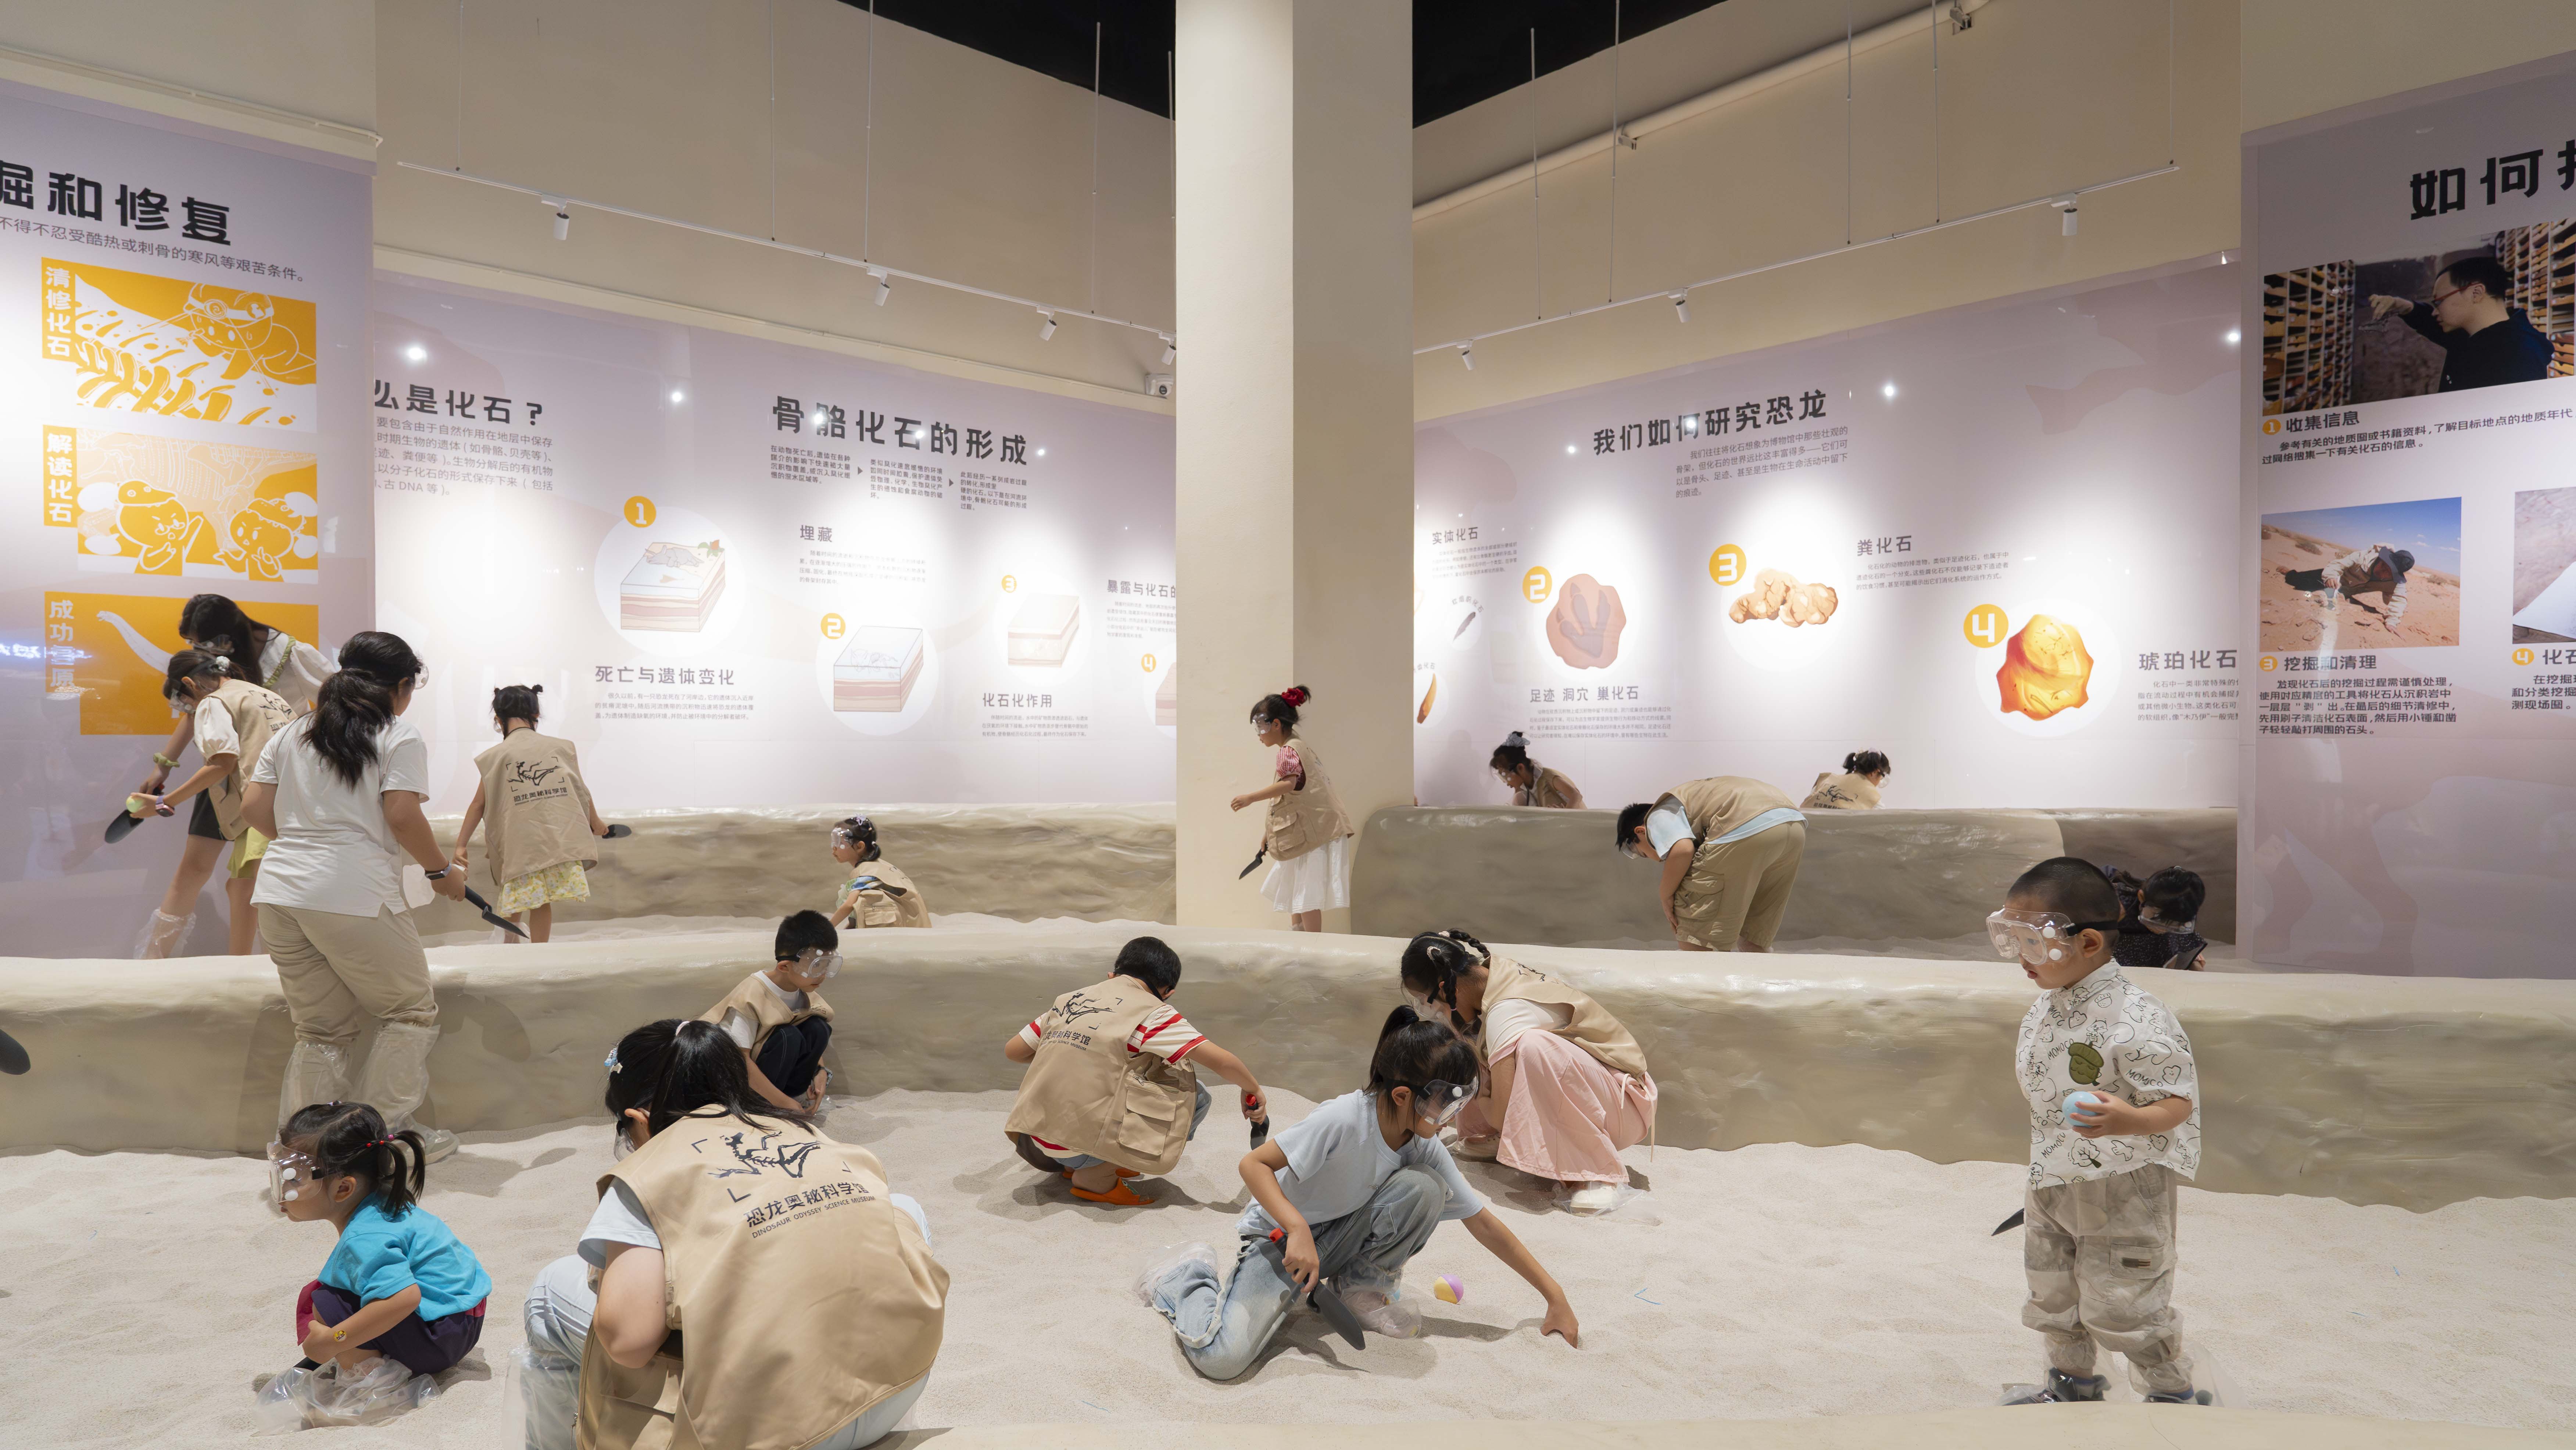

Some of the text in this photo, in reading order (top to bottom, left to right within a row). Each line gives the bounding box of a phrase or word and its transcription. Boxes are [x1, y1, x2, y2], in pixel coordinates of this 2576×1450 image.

[0, 216, 303, 282] 不得不忍受酷热或刺骨的寒风等艰苦条件。
[46, 267, 71, 357] 清修化石
[773, 396, 1027, 466] 骨骼化石的形成
[1593, 388, 1827, 456] 我们如何研究恐龙
[2286, 411, 2360, 433] 收集信息
[374, 432, 552, 462] 时期生物的遗体（如骨骼、贝壳等）、
[1690, 426, 1848, 460] 我们往往将化石想象为博物馆中那些壮观的
[47, 433, 73, 524] 解读化石
[374, 464, 553, 491] 以分子化石的形式保存下来（包括
[374, 479, 395, 490] 、古
[399, 481, 423, 492] DNA
[635, 503, 647, 525] 1
[800, 525, 833, 542] 埋藏
[1432, 526, 1479, 545] 实体化石
[1857, 535, 1912, 556] 粪化石
[1718, 553, 1737, 582] 3
[1005, 578, 1015, 590] 3
[1530, 574, 1546, 600] 2
[828, 618, 841, 637] 2
[1972, 613, 1995, 643] 4
[1144, 657, 1153, 670] 4
[2139, 650, 2237, 671] 琥珀化石
[2284, 655, 2377, 671] 挖掘和清理
[2517, 651, 2529, 663] 4
[595, 665, 735, 685] 死亡与遗体变化
[2533, 674, 2576, 684] 在挖掘
[983, 693, 1052, 708] 化石化作用
[1530, 686, 1638, 703] 足迹 洞穴 巢化石
[2512, 700, 2571, 710] 测现场图。
[2138, 701, 2239, 710] 或其他微小生物。这类化石可
[1070, 1043, 1087, 1051] MUSEUM
[743, 1181, 870, 1228] 恐龙奥秘科学馆
[752, 1217, 791, 1238] DINOSAUR
[794, 1207, 822, 1220] ODYSSEY
[824, 1199, 849, 1210] SCIENCE
